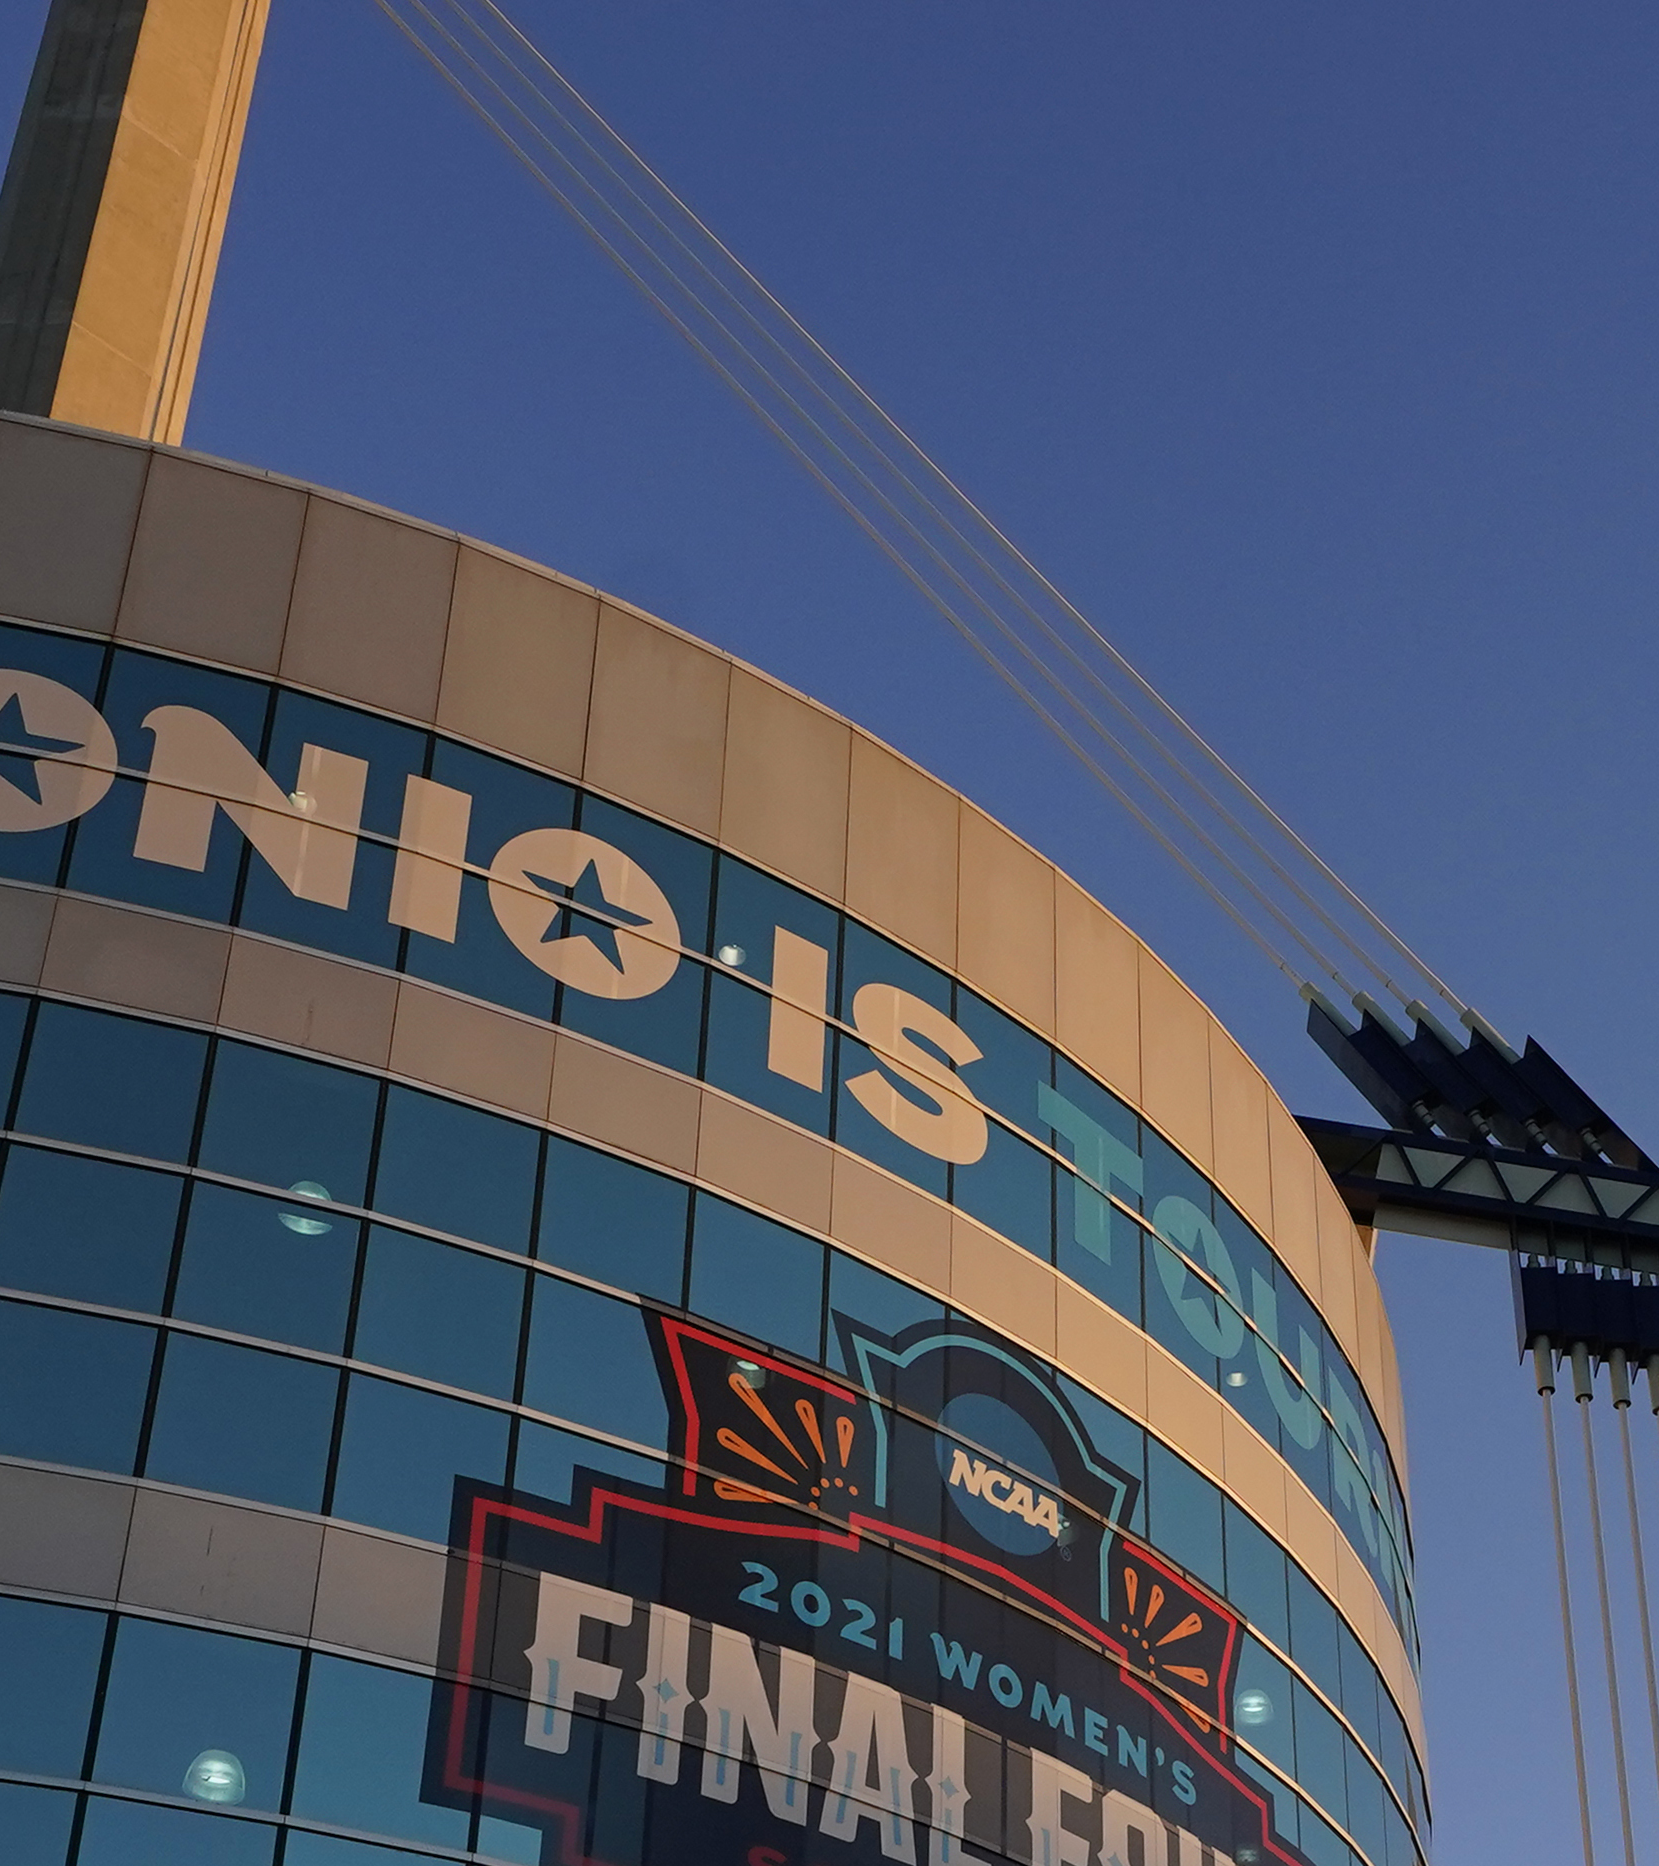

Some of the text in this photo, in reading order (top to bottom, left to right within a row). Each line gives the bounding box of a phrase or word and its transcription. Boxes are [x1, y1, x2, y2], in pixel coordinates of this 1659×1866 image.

[768, 925, 989, 1166] IS
[948, 1448, 1060, 1538] NCAA
[738, 1561, 1197, 1806] 2021 WOMEN'S
